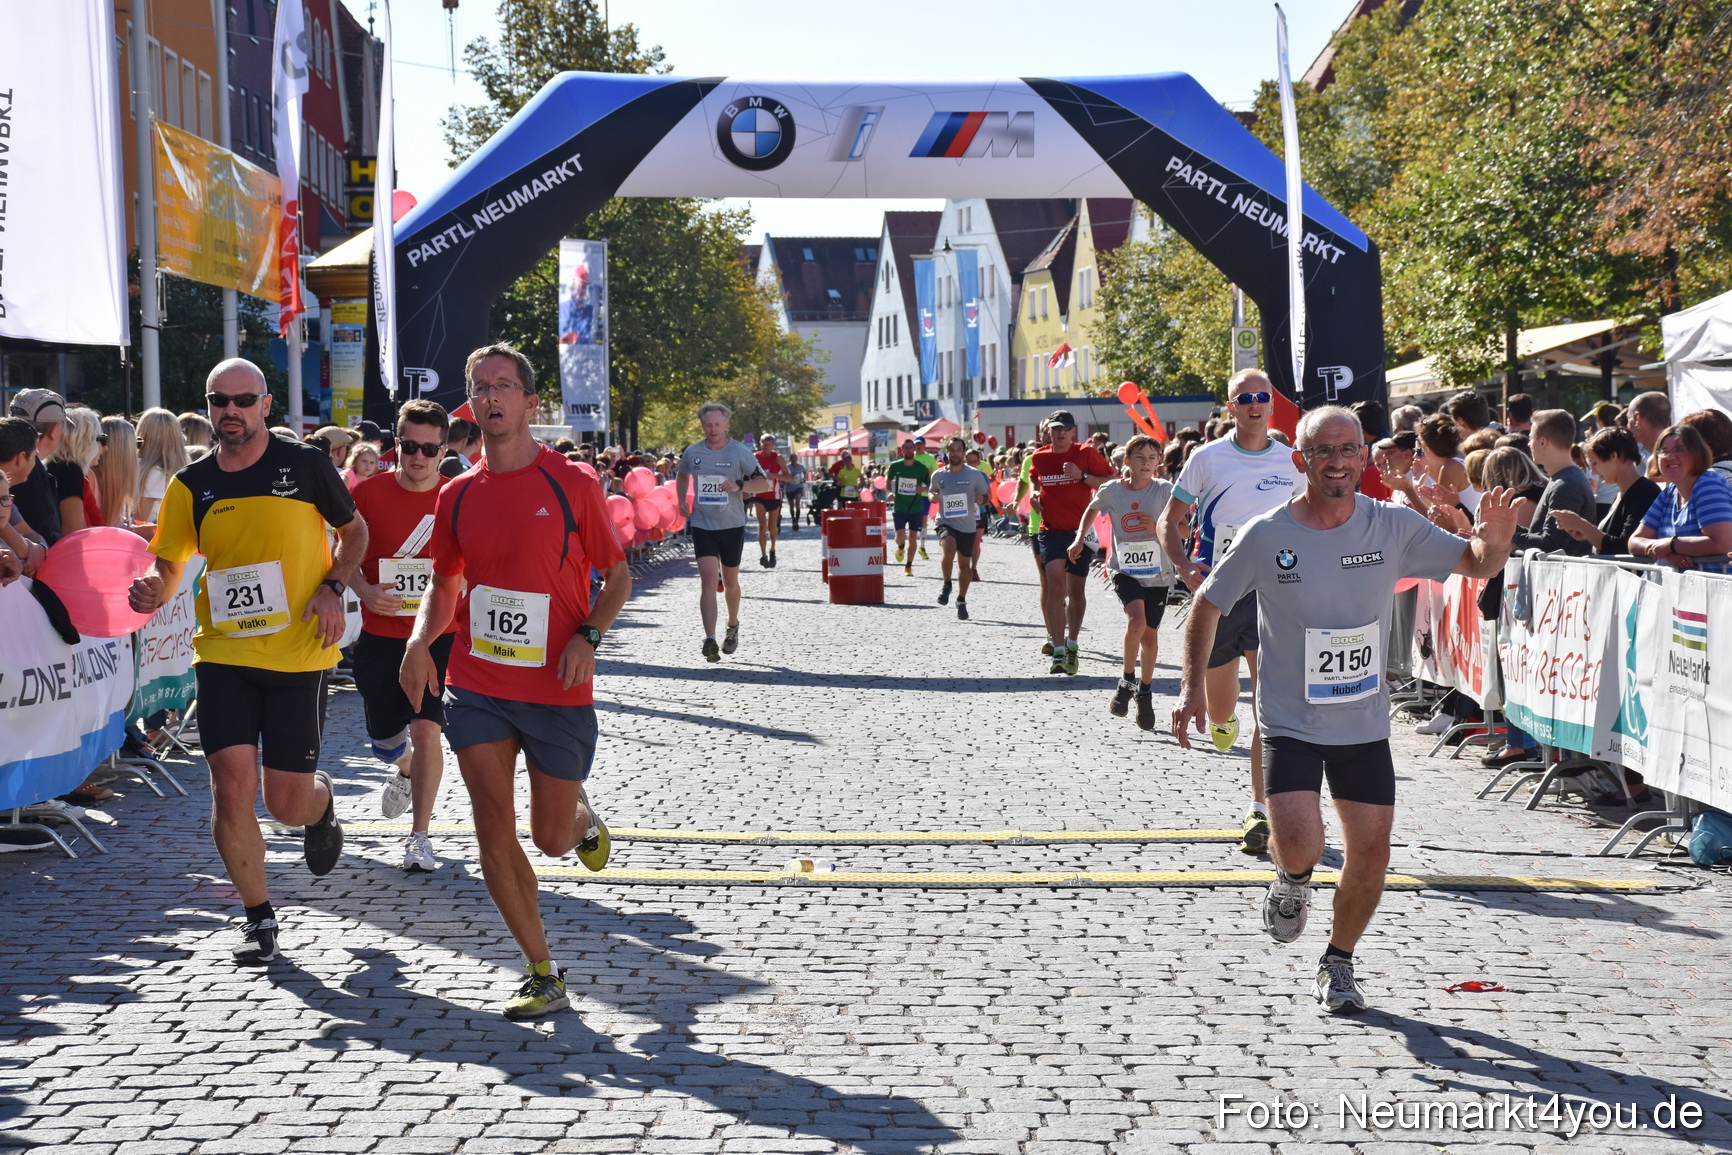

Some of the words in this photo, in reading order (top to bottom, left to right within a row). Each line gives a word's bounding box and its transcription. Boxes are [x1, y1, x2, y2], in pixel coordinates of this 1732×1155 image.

[723, 96, 788, 119] BMW
[406, 221, 475, 268] PARTL
[472, 153, 583, 230] NEUMARKT
[1164, 155, 1228, 205] PARTL
[1231, 192, 1346, 264] NEUMRKT
[377, 461, 395, 470] BM
[271, 487, 299, 498] Burgthann
[212, 505, 235, 515] Vlatko
[946, 500, 964, 508] 3095
[1124, 551, 1154, 564] 2047
[1341, 551, 1383, 565] BOCK
[227, 570, 260, 583] BOCK
[225, 583, 265, 610] 231
[491, 594, 525, 607] BOCK
[401, 600, 420, 610] Öme
[228, 610, 244, 618] PARTL
[244, 607, 266, 615] Neumarkt
[237, 618, 267, 630] Vlatko
[487, 609, 528, 636] 162
[484, 632, 499, 641] PARTL
[499, 636, 523, 644] Neumarkt
[1331, 633, 1364, 644] BOCK
[493, 645, 516, 658] Maik
[1318, 645, 1372, 673] 2150
[1331, 683, 1362, 695] Hubert
